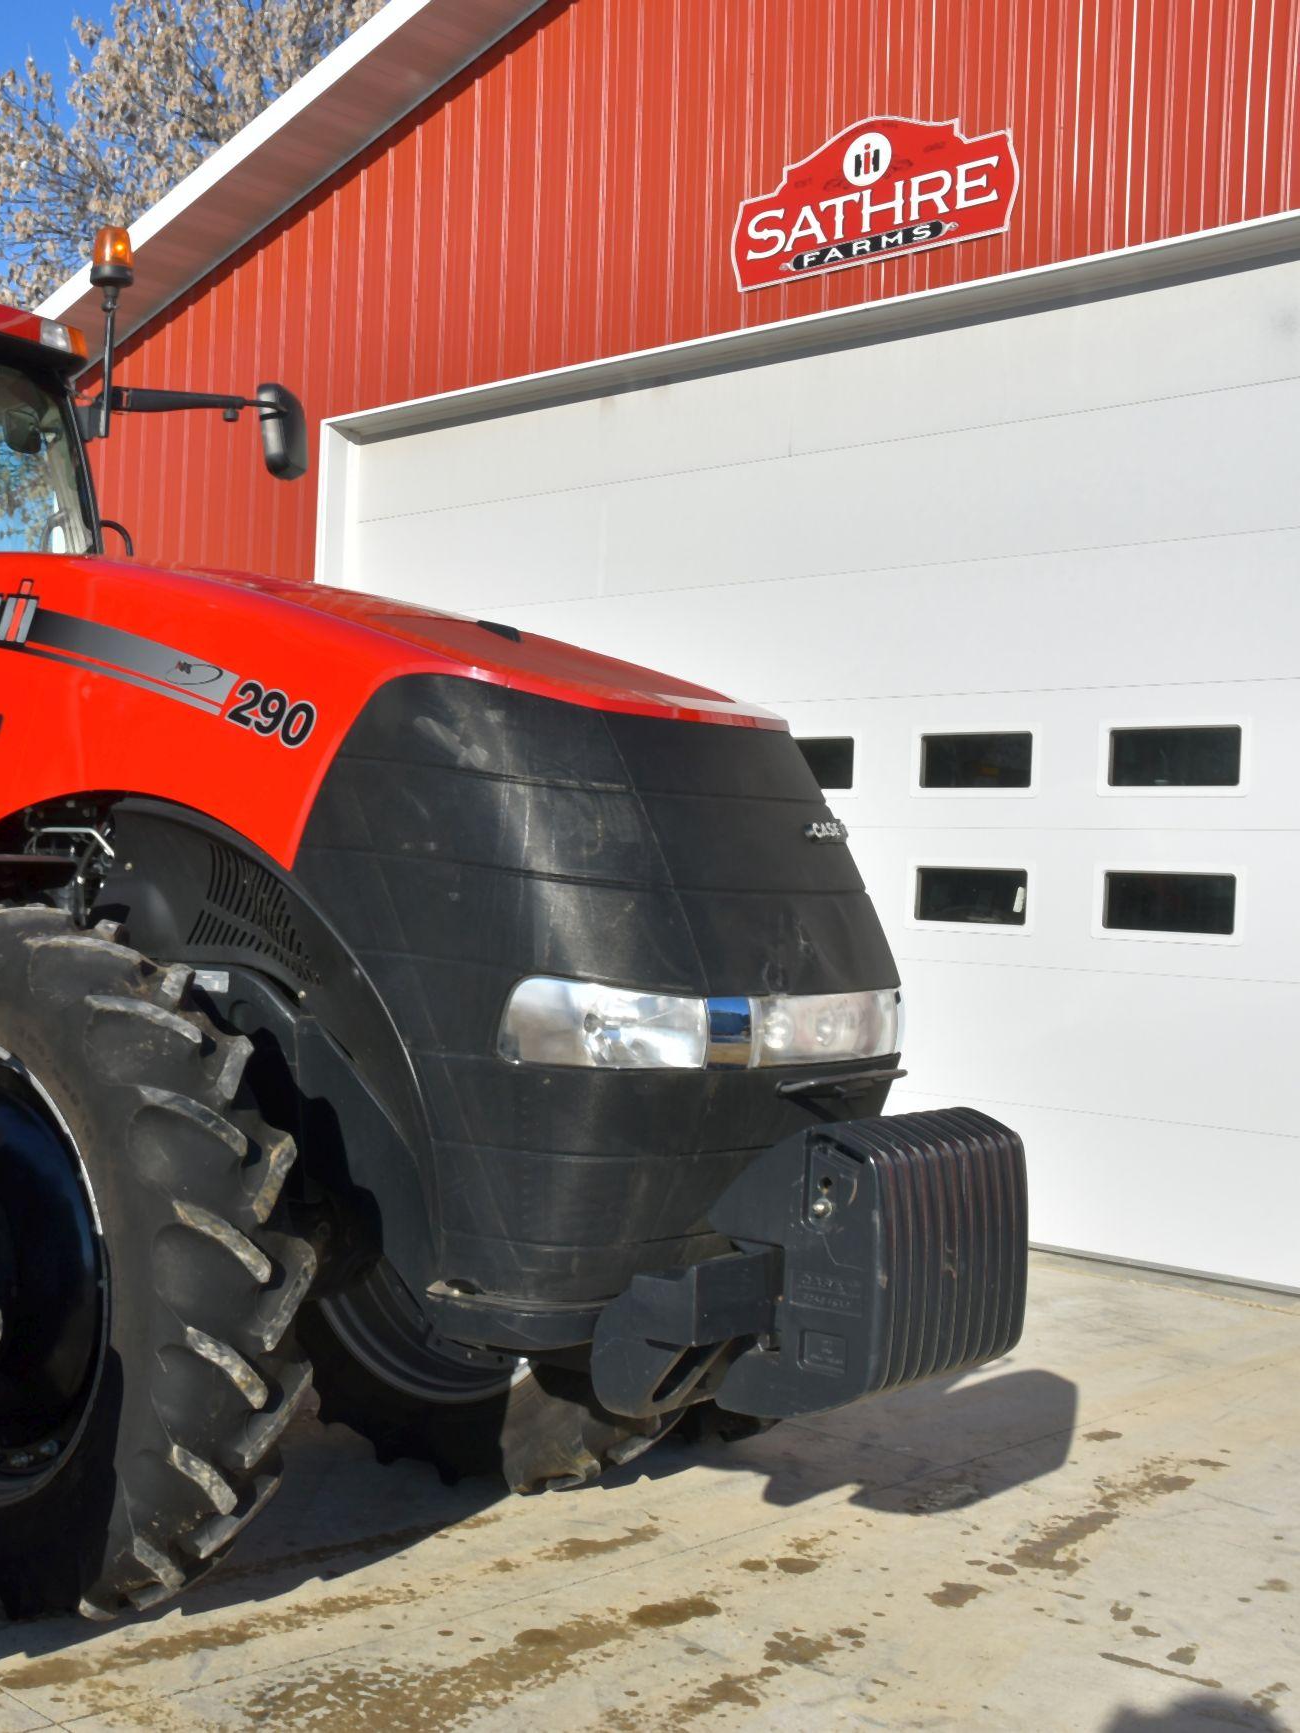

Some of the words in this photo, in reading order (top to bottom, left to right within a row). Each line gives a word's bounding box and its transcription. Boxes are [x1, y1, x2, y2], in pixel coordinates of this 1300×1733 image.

[746, 155, 999, 260] SATHRE
[803, 224, 932, 267] FARMS
[225, 680, 317, 749] 290
